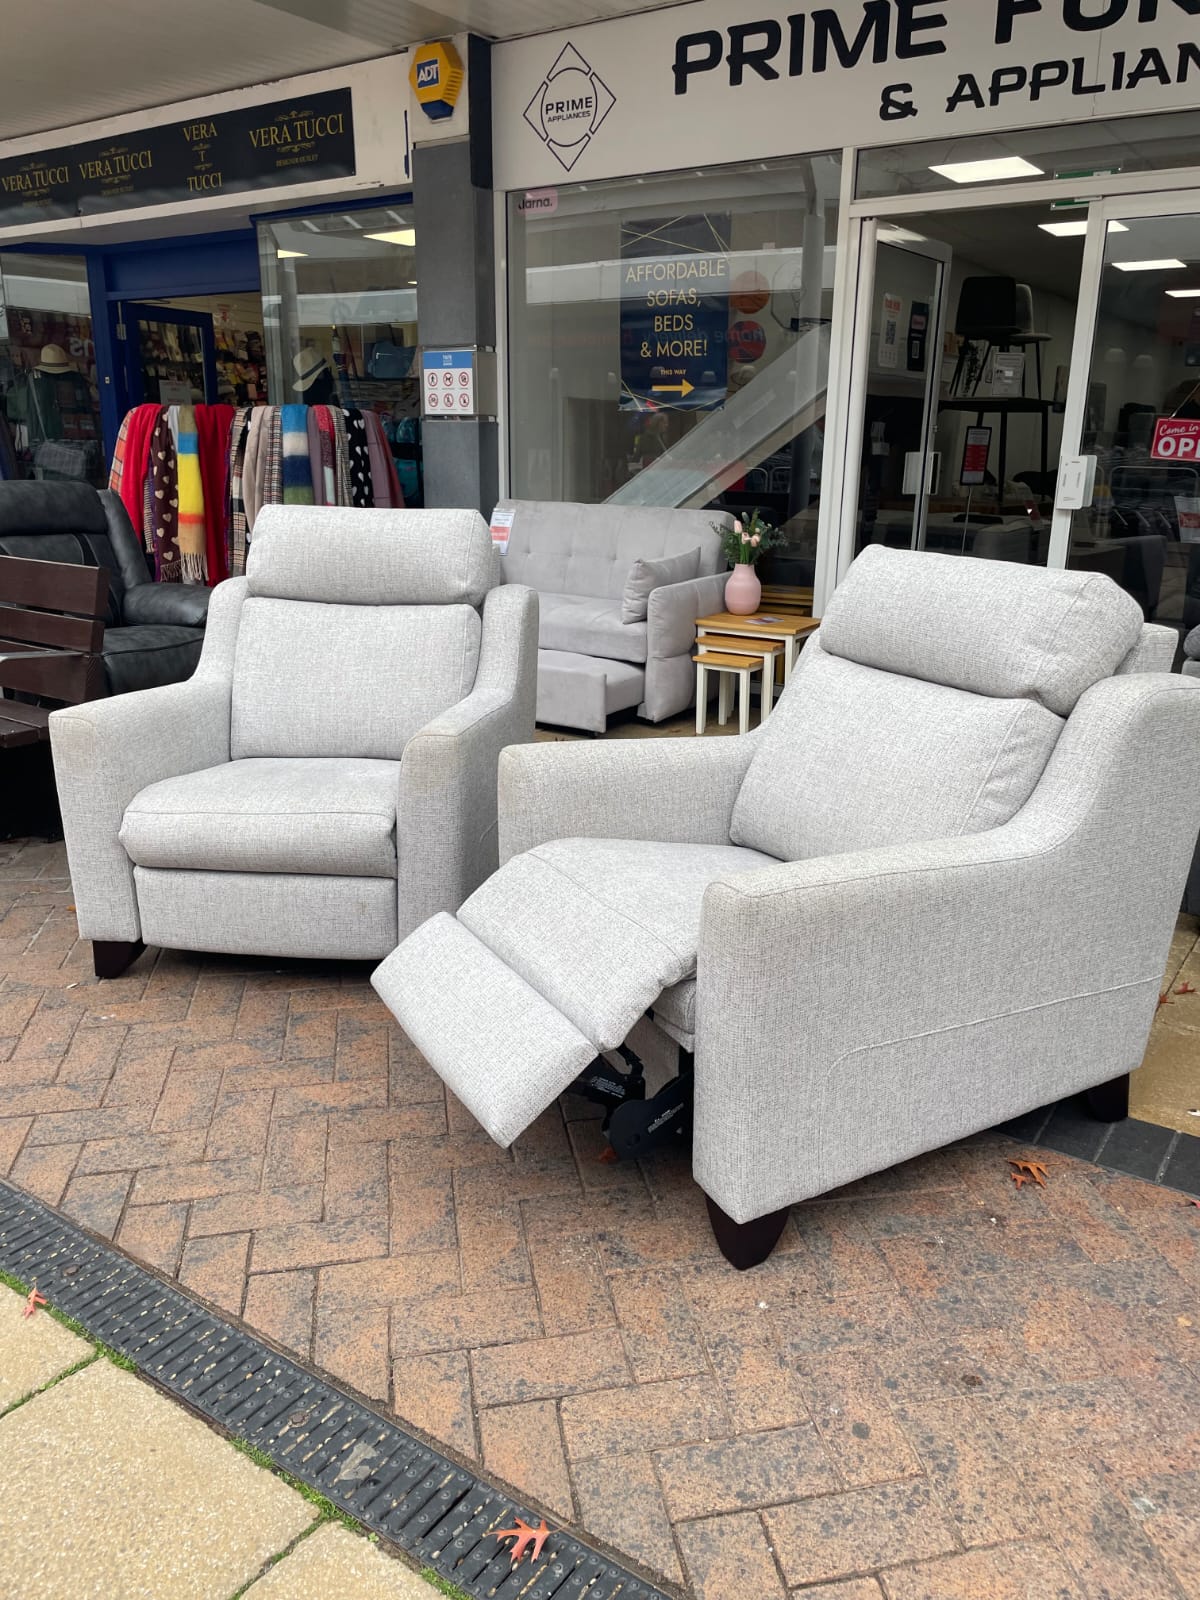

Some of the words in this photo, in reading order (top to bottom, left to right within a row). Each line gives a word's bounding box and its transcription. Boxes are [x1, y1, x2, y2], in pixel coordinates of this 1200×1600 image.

[672, 0, 947, 95] PRIME
[417, 64, 439, 83] ADT
[545, 96, 593, 115] PRIME
[879, 83, 918, 120] &
[547, 110, 591, 123] APPLIANCES
[183, 122, 218, 142] VERA
[249, 124, 292, 149] VERA
[294, 113, 344, 141] TUCCI
[79, 160, 112, 180] VERA
[114, 150, 153, 174] TUCCI
[2, 174, 32, 192] VERA
[32, 166, 70, 187] TUCCI
[187, 172, 223, 192] TUCCI
[625, 259, 726, 283] AFFORDABLE
[646, 287, 702, 308] SOFAS,
[654, 314, 694, 332] BEDS
[640, 342, 652, 358] &
[656, 339, 708, 357] MORE!
[1160, 424, 1186, 436] Come
[1189, 423, 1199, 433] in
[1157, 436, 1200, 459] OP
